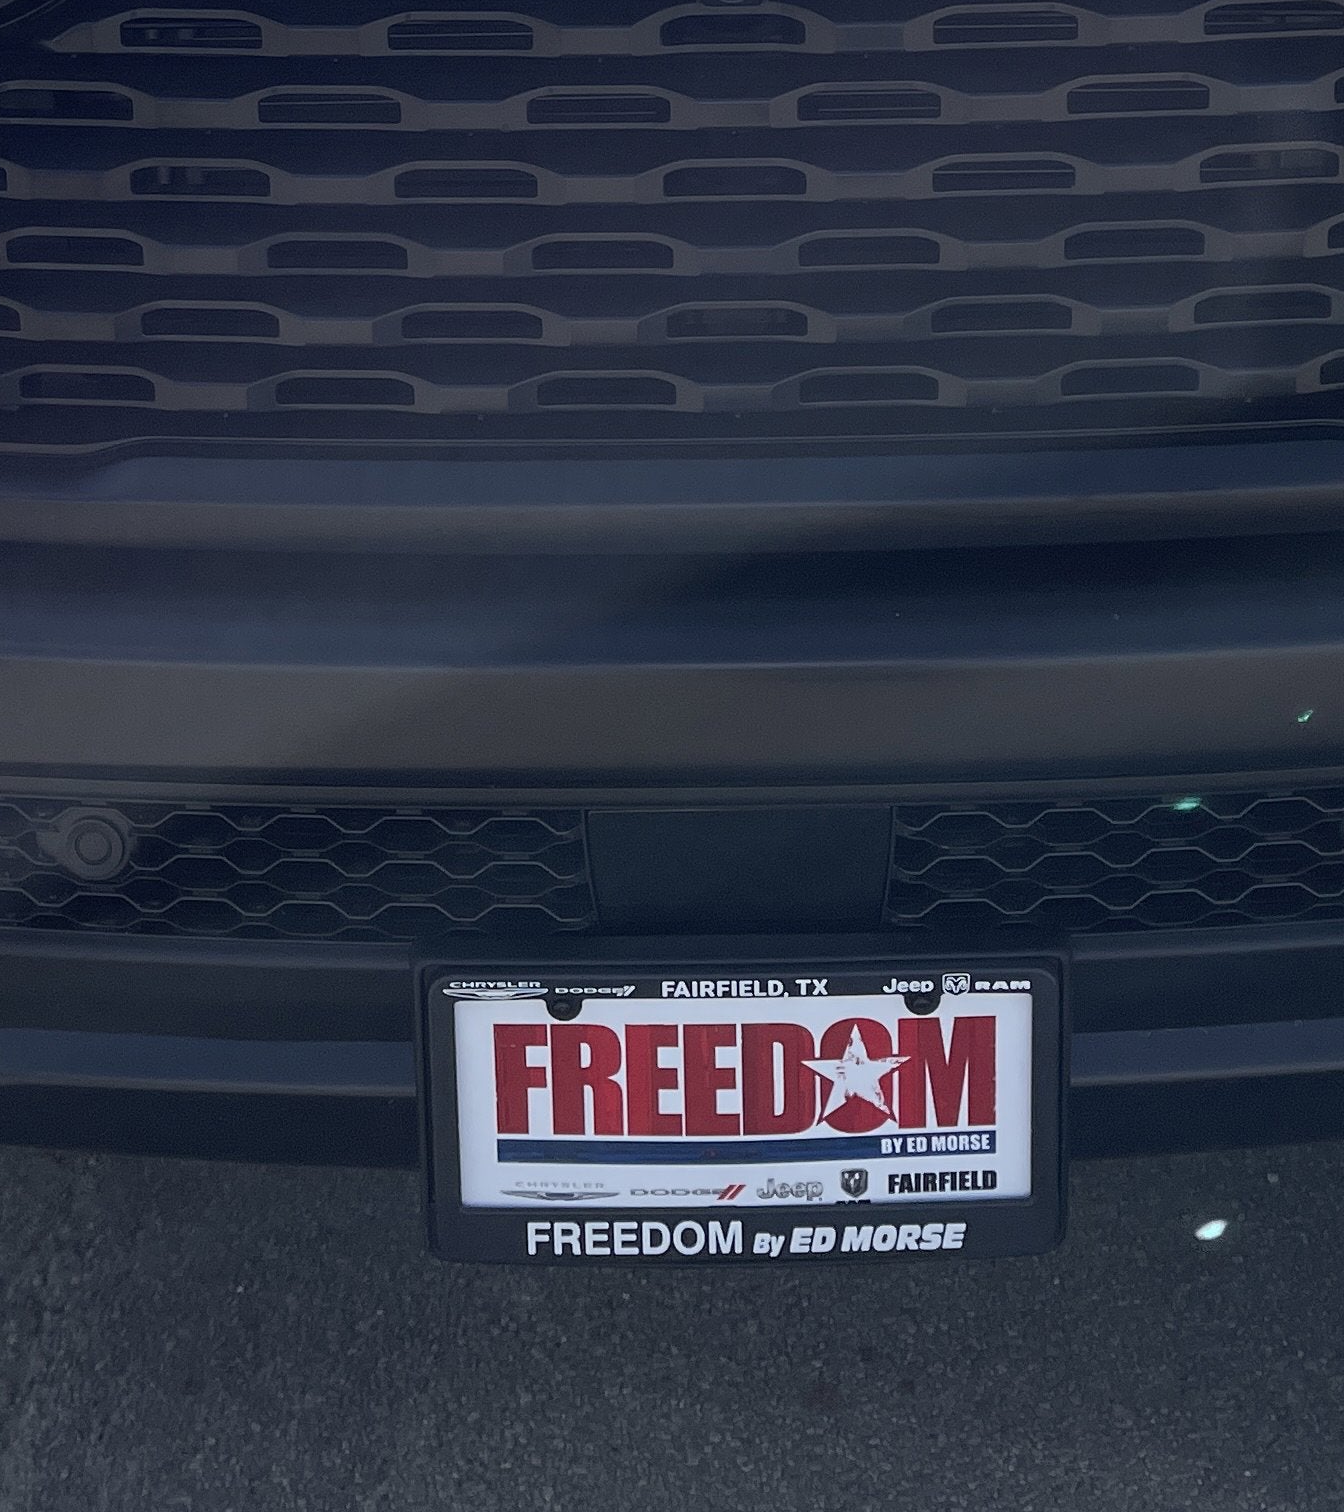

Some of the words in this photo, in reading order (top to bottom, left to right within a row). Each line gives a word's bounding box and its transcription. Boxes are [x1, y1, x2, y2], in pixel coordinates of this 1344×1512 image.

[449, 981, 541, 989] CHRYSLER
[661, 980, 789, 998] FAIRFIELD,
[795, 979, 829, 996] TX
[882, 978, 934, 994] Jeep
[974, 980, 1031, 990] RAM
[492, 1015, 997, 1137] FREEDOM
[880, 1138, 904, 1155] BY
[906, 1136, 928, 1154] ED
[931, 1134, 991, 1152] MORSE
[756, 1178, 824, 1202] Jeep
[887, 1170, 998, 1194] FAIRFIELD
[526, 1220, 744, 1256] FREEDOM
[752, 1232, 785, 1258] By
[789, 1226, 837, 1254] ED
[840, 1222, 967, 1253] MORSE
